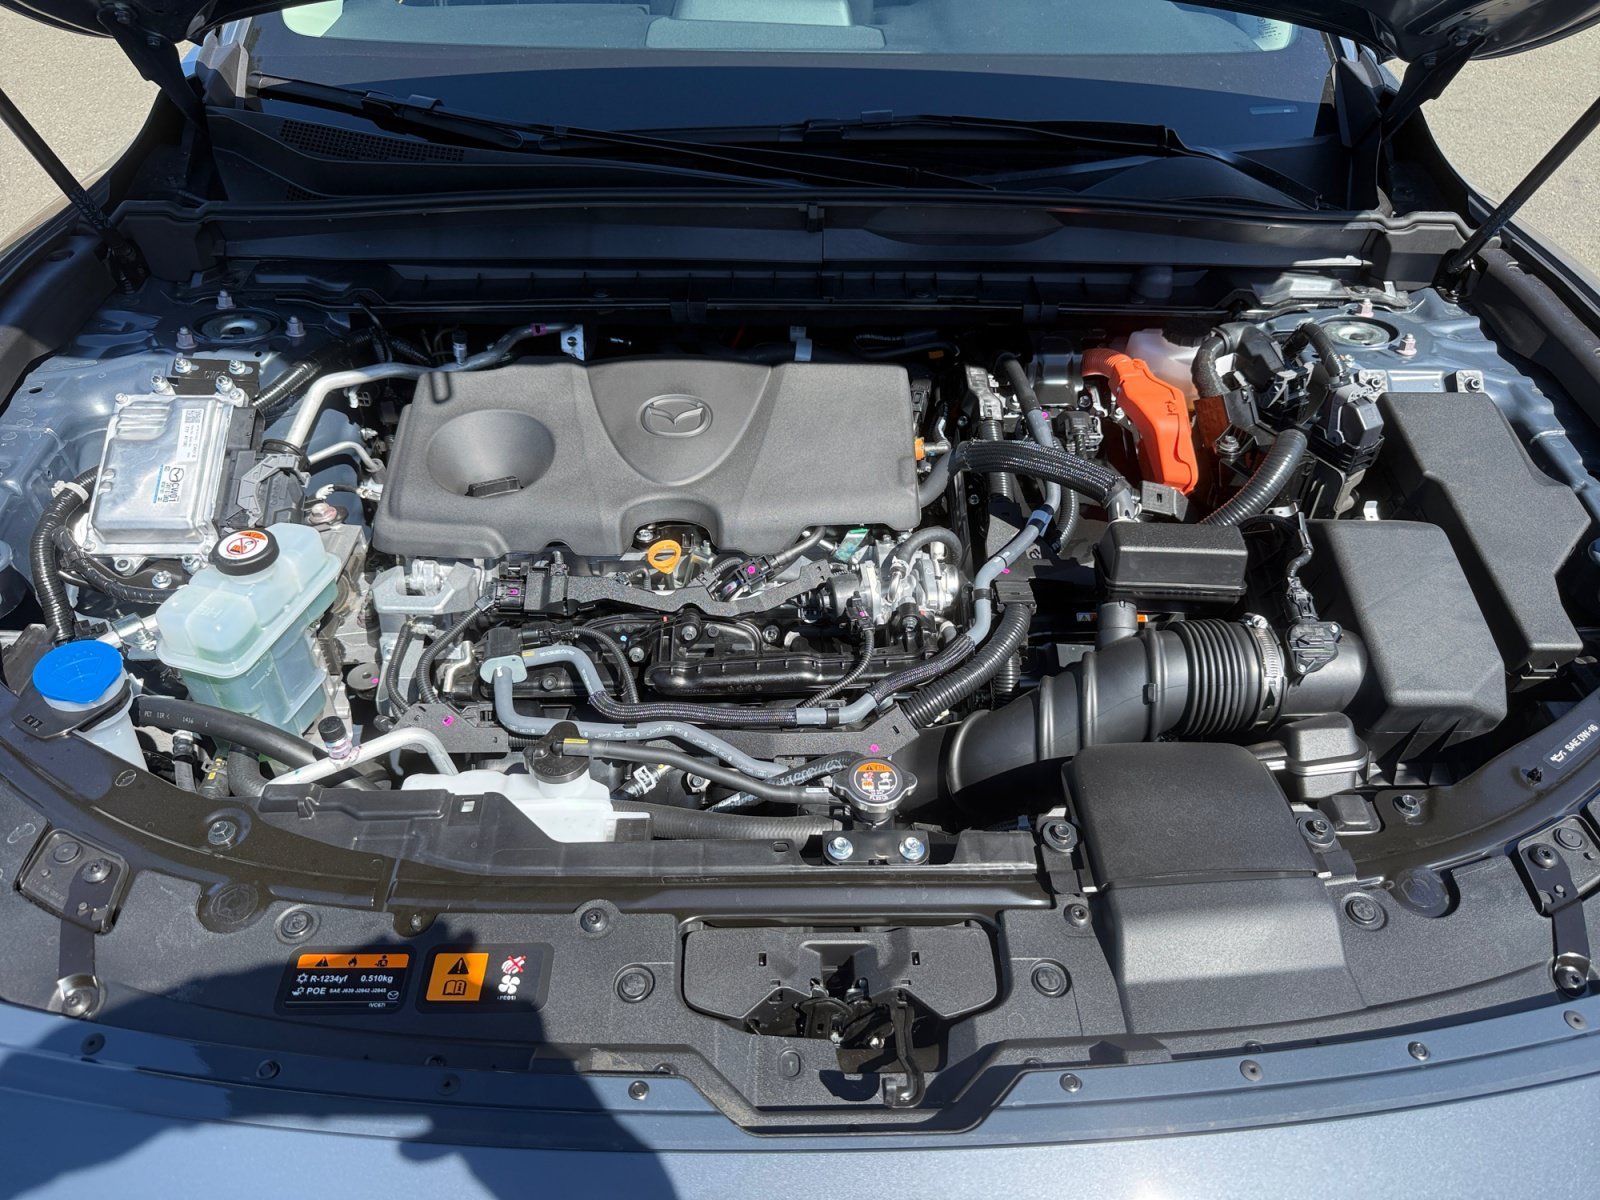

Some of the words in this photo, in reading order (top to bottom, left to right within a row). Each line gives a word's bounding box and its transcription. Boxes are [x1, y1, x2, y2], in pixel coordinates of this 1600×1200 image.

[1564, 738, 1582, 752] SAE
[309, 974, 349, 984] R-1234yf
[360, 974, 394, 984] 0.510kg
[306, 987, 327, 996] POE
